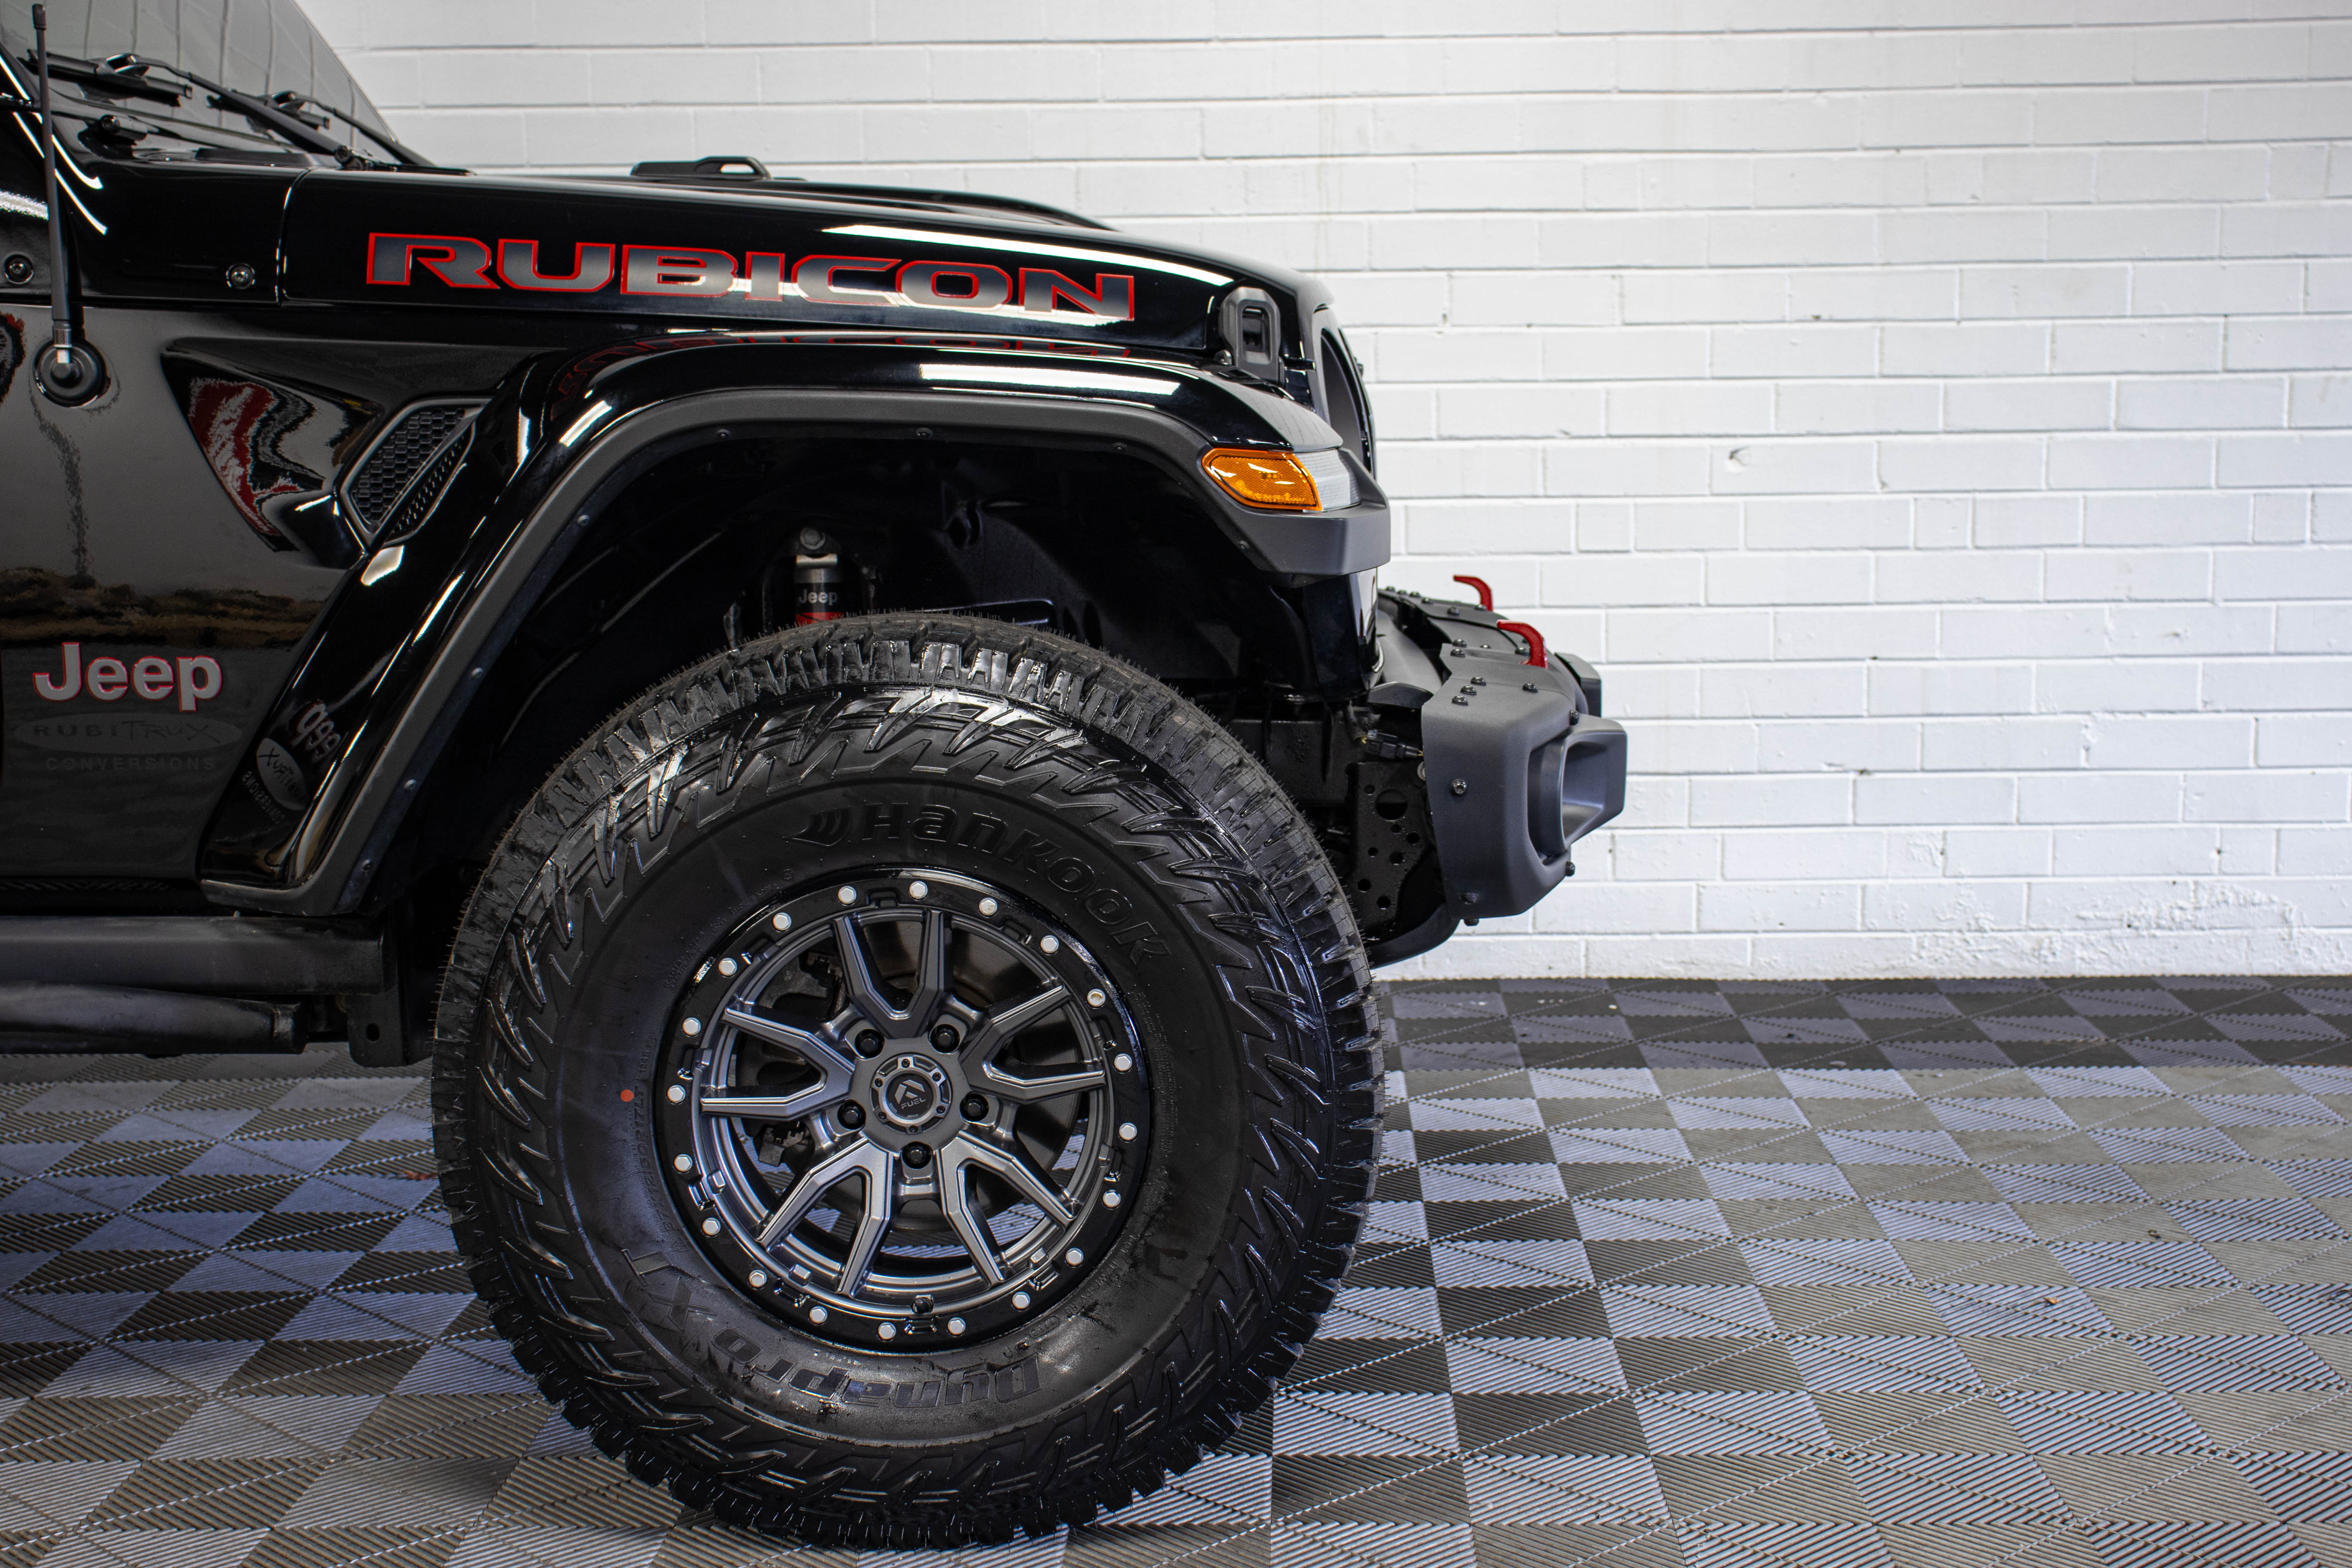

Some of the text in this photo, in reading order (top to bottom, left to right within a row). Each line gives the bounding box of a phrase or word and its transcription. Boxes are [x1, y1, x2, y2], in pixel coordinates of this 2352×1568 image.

[366, 231, 1135, 322] RUBICON
[798, 588, 838, 606] Jeep
[33, 642, 223, 712] Jeep
[32, 720, 221, 743] RUBITRUX
[45, 756, 217, 772] CONVERSIONS
[901, 1097, 926, 1110] FUEL
[620, 1247, 1044, 1408] Dynapro XT
